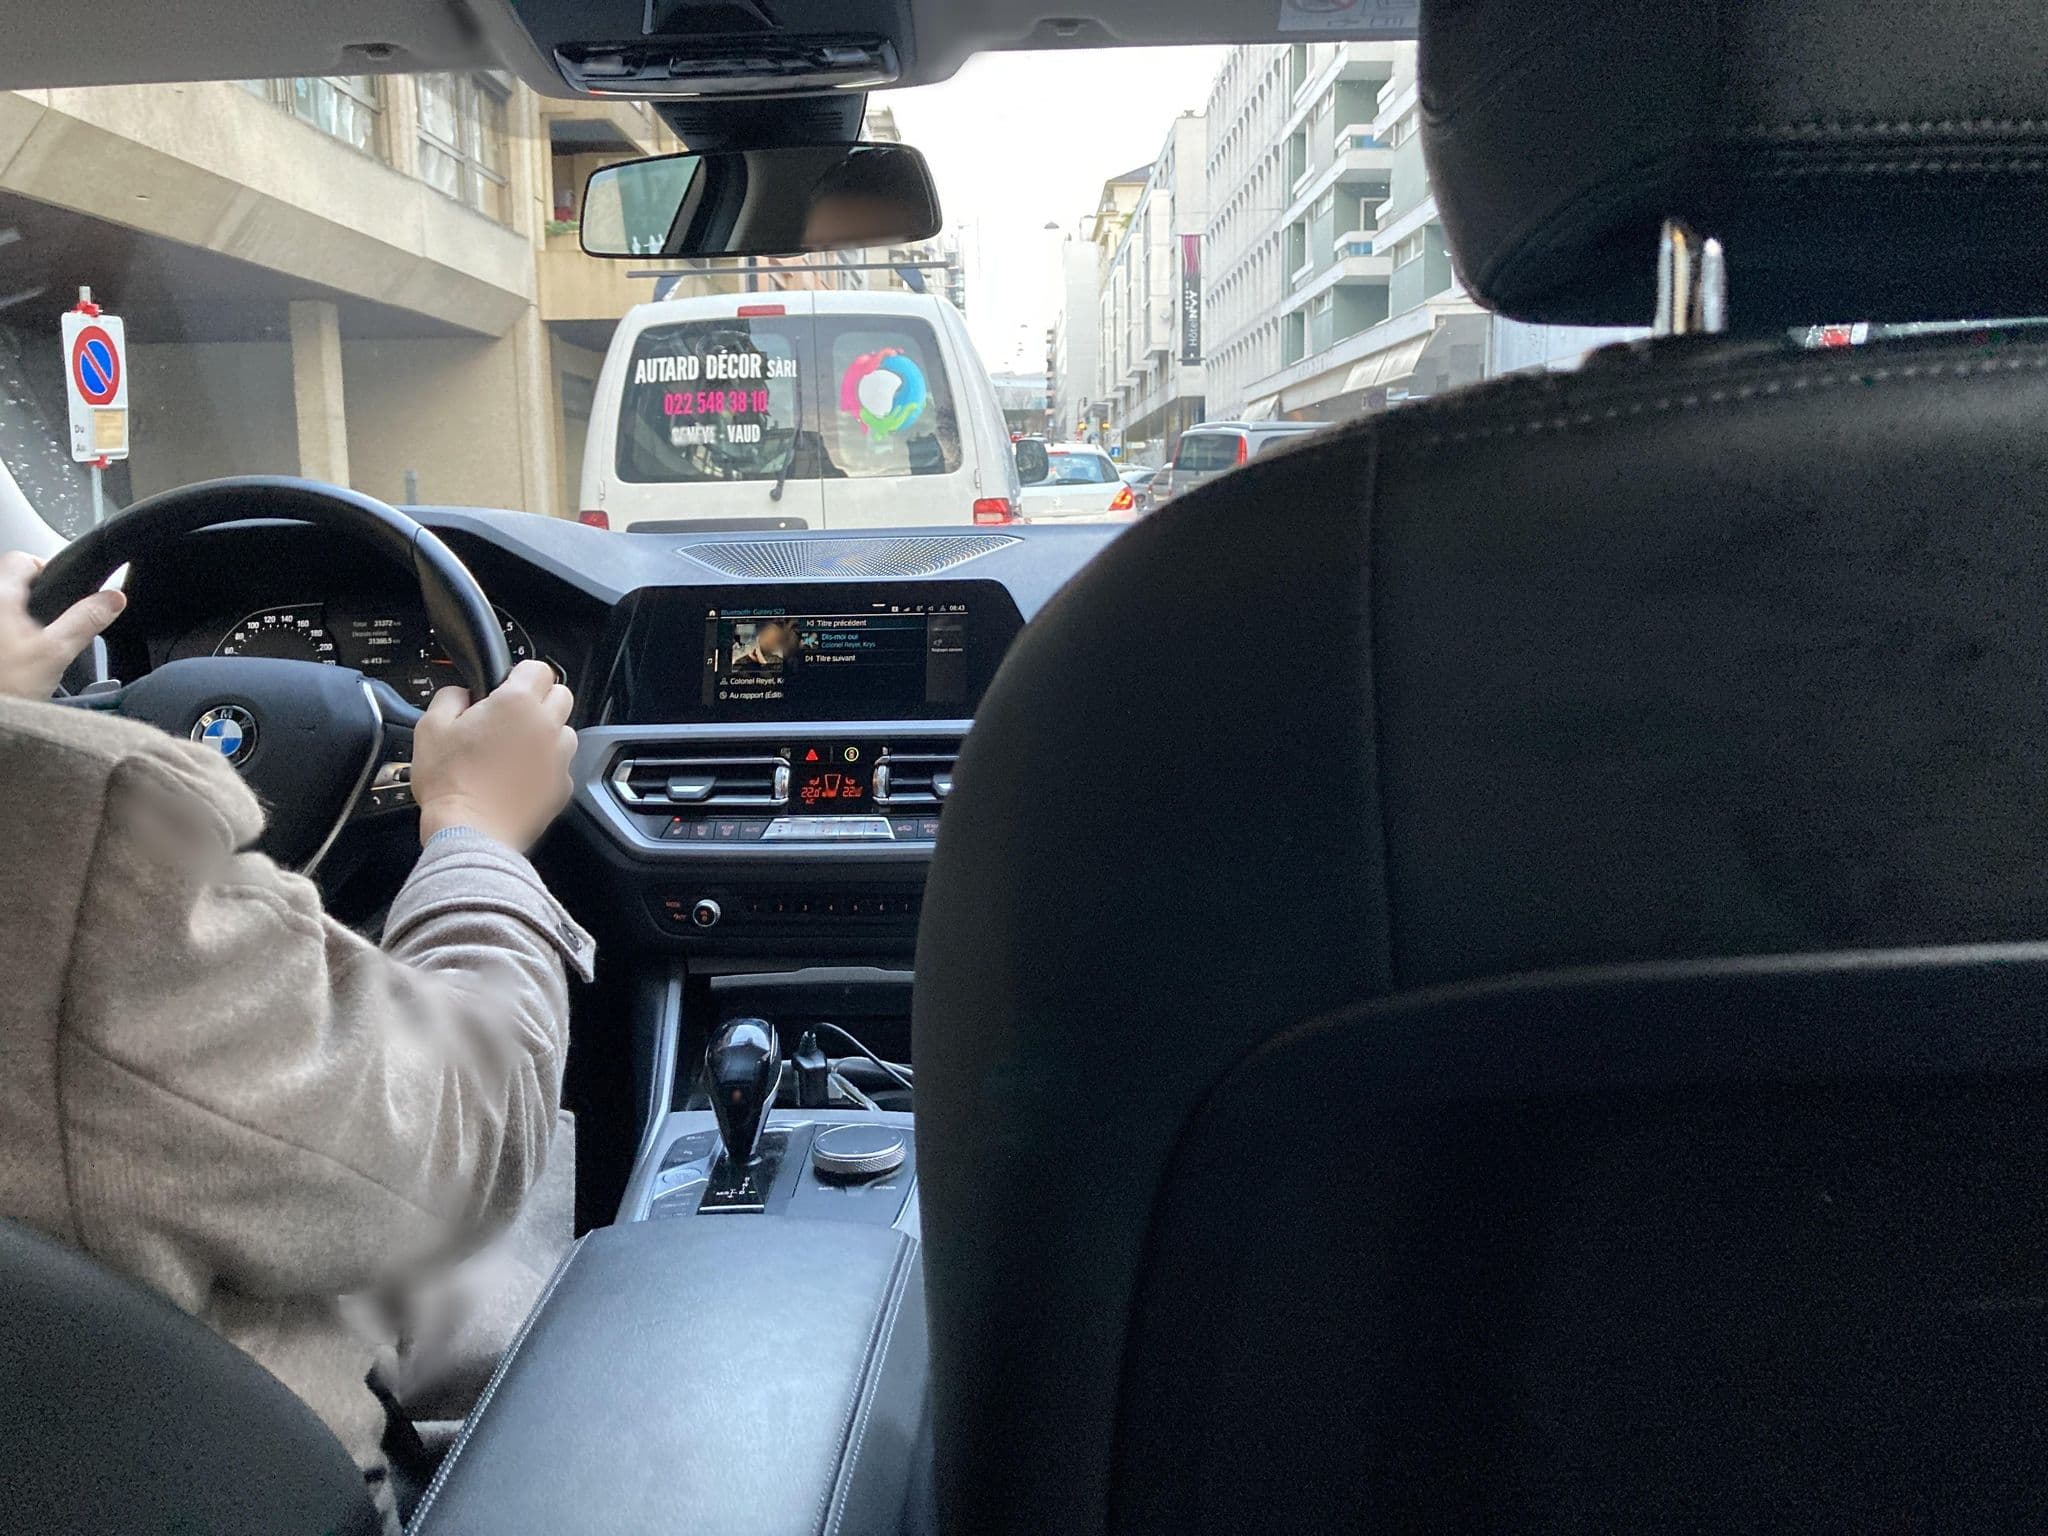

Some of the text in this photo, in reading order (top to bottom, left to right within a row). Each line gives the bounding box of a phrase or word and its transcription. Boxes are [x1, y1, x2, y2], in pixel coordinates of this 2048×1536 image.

[634, 356, 699, 384] AUTARD
[706, 350, 762, 379] DÉCOR
[664, 389, 768, 416] 022 548 38 10
[727, 424, 761, 443] VAUD
[264, 615, 276, 623] 120
[281, 615, 293, 623] 140
[817, 619, 867, 628] Titre précédent
[247, 621, 260, 629] 100
[507, 621, 513, 631] 5
[821, 633, 846, 641] Dis-moi
[420, 649, 426, 658] 1
[518, 645, 525, 655] 6
[832, 654, 856, 662] suivant
[730, 677, 755, 685] Colonel
[729, 691, 739, 699] Au
[740, 691, 764, 700] rapport
